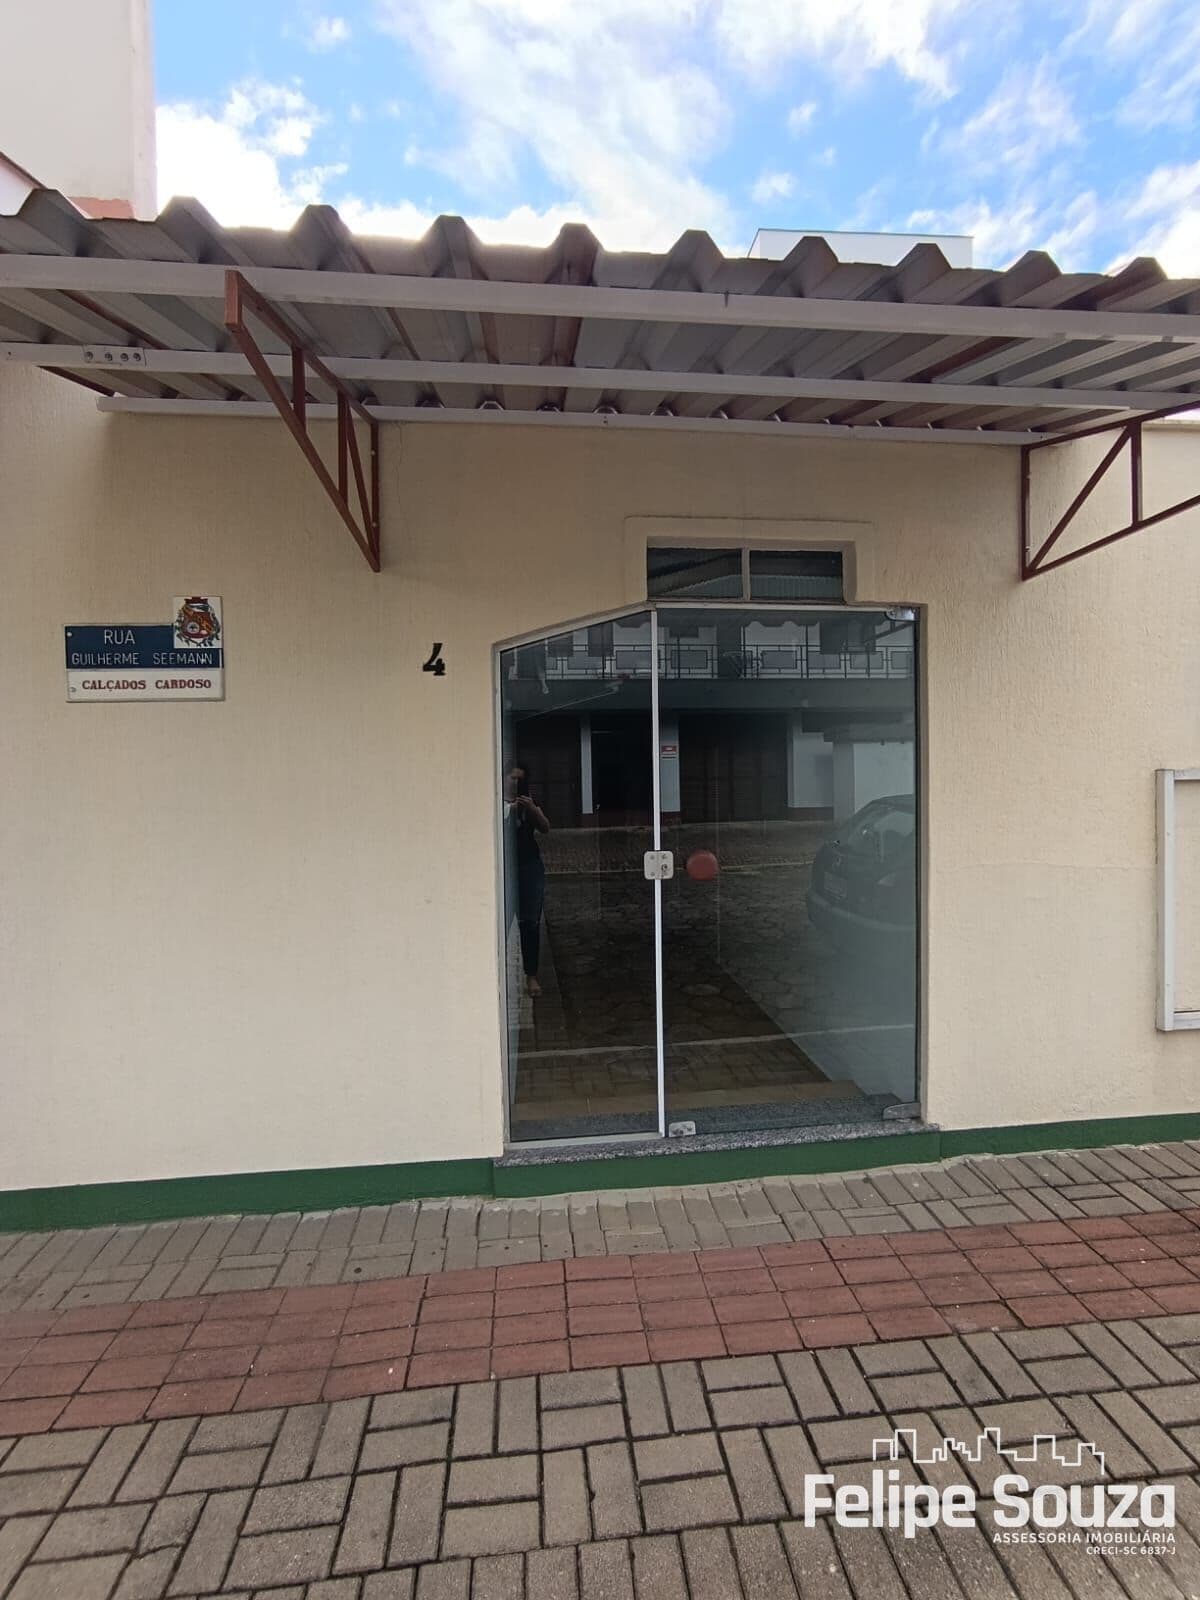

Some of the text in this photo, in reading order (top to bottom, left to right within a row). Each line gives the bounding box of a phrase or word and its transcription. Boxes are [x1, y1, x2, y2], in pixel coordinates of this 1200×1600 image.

[103, 629, 136, 645] RUA
[71, 652, 213, 666] GUILHERME SEEMANN
[422, 642, 446, 676] 4
[82, 679, 212, 692] CALÇADOS CARDOSO
